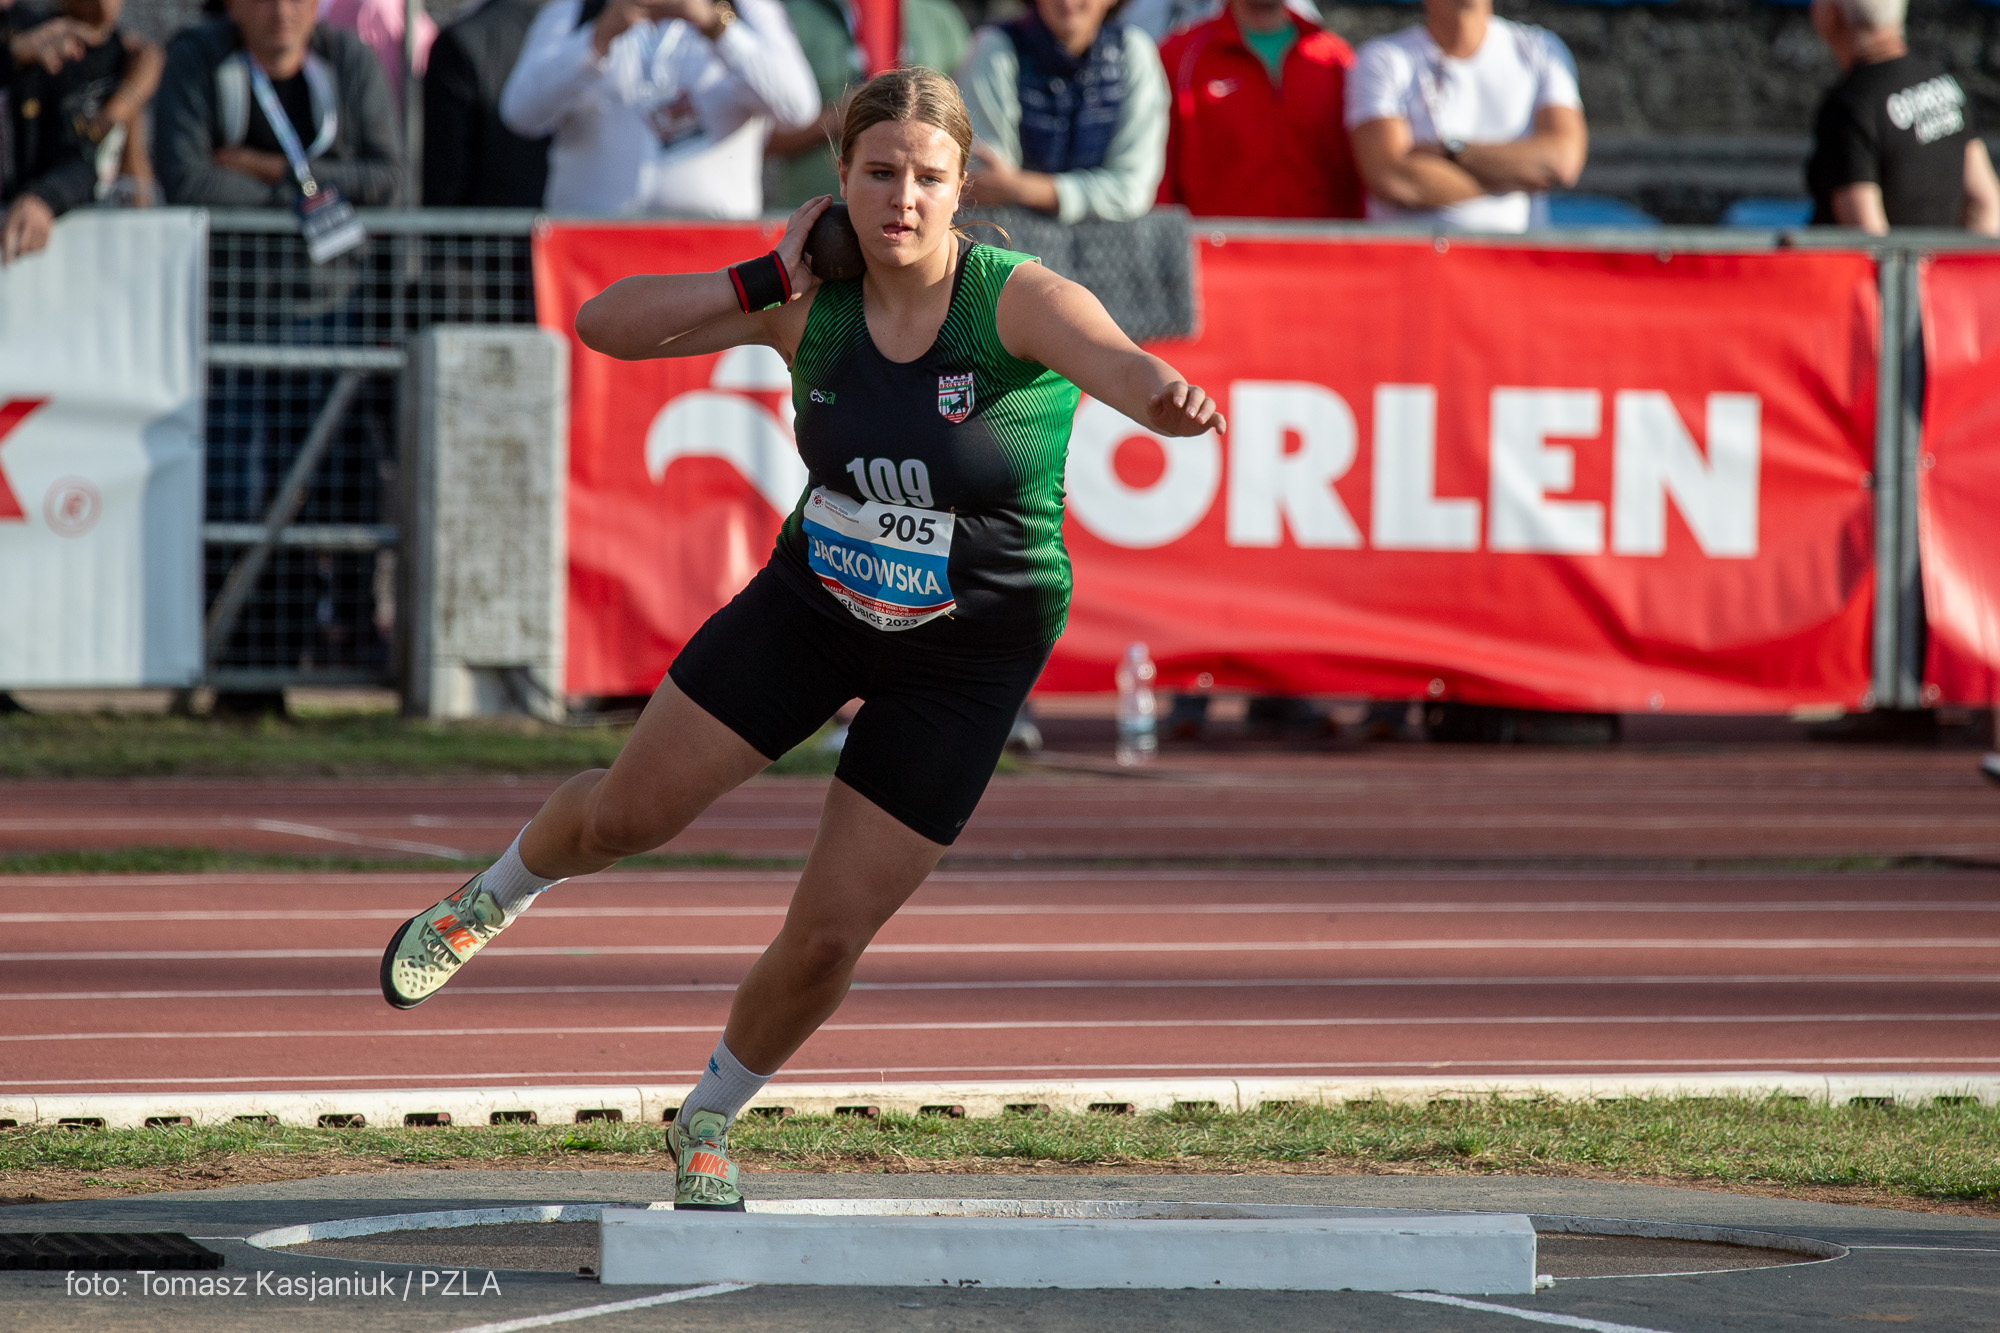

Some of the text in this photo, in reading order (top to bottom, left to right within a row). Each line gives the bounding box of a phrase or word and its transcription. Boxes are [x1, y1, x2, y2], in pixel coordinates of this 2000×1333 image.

[846, 457, 935, 508] 109
[1065, 380, 1762, 559] ORLEN
[878, 512, 936, 545] 905
[811, 536, 943, 595] JACKOWSKA
[841, 599, 918, 627] SŁUBICE 2023
[687, 1152, 730, 1179] NIKE
